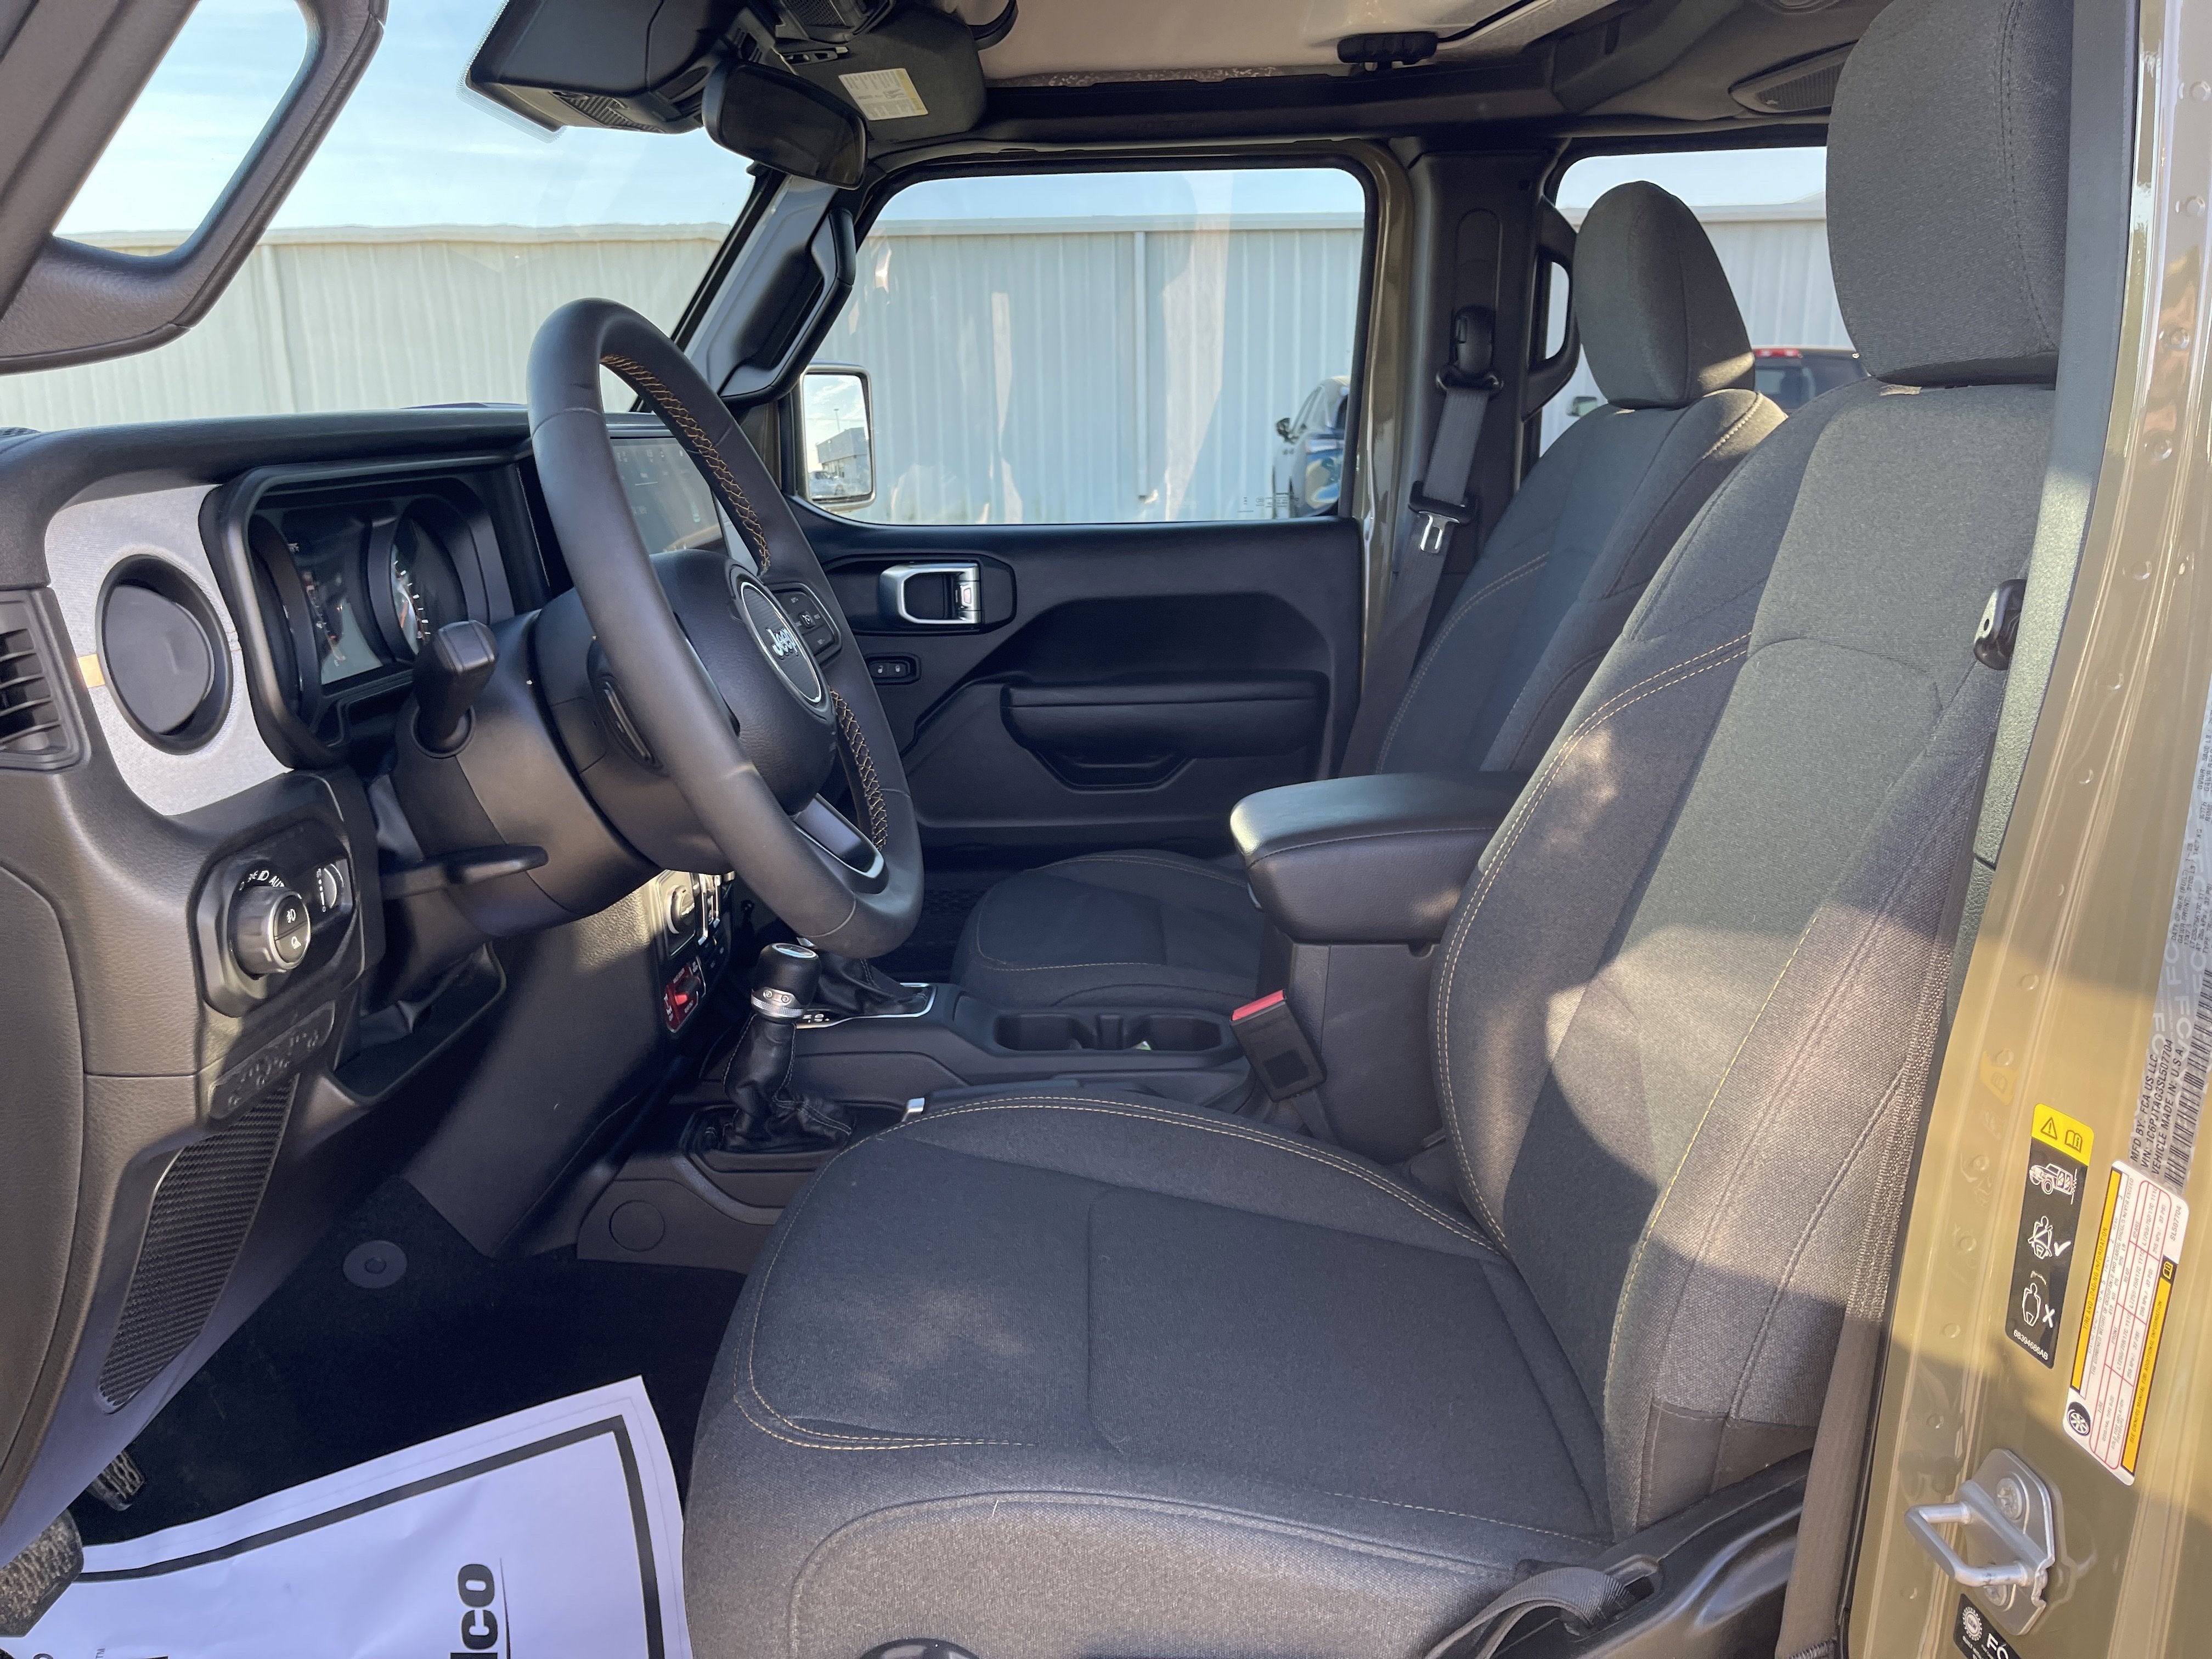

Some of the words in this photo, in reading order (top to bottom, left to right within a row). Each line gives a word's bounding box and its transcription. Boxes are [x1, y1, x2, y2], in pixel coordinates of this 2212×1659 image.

[767, 629, 798, 656] Jeep
[2147, 1053, 2158, 1073] LLC
[2143, 1075, 2154, 1091] US
[2166, 1081, 2177, 1096] IN:
[2139, 1094, 2151, 1114] FCA
[2160, 1097, 2174, 1130] MADE
[2135, 1118, 2146, 1136] BY:
[2130, 1138, 2142, 1162] MFD
[2140, 1146, 2153, 1168] VIN:
[2151, 1131, 2167, 1175] VEHICLE
[2169, 1204, 2181, 1242] SL507704
[2089, 1271, 2099, 1300] LOADING
[2095, 1226, 2108, 1271] INFORMATION
[2104, 1273, 2114, 1306] OCCUPANTS
[2103, 1306, 2108, 1314] OF
[2092, 1335, 2102, 1364] COMBINED
[2136, 1384, 2145, 1408] MANUAL
[2143, 1339, 2153, 1372] ADDITIONAL
[2151, 1299, 2162, 1339] INFORMATION
[450, 1564, 498, 1659] co
